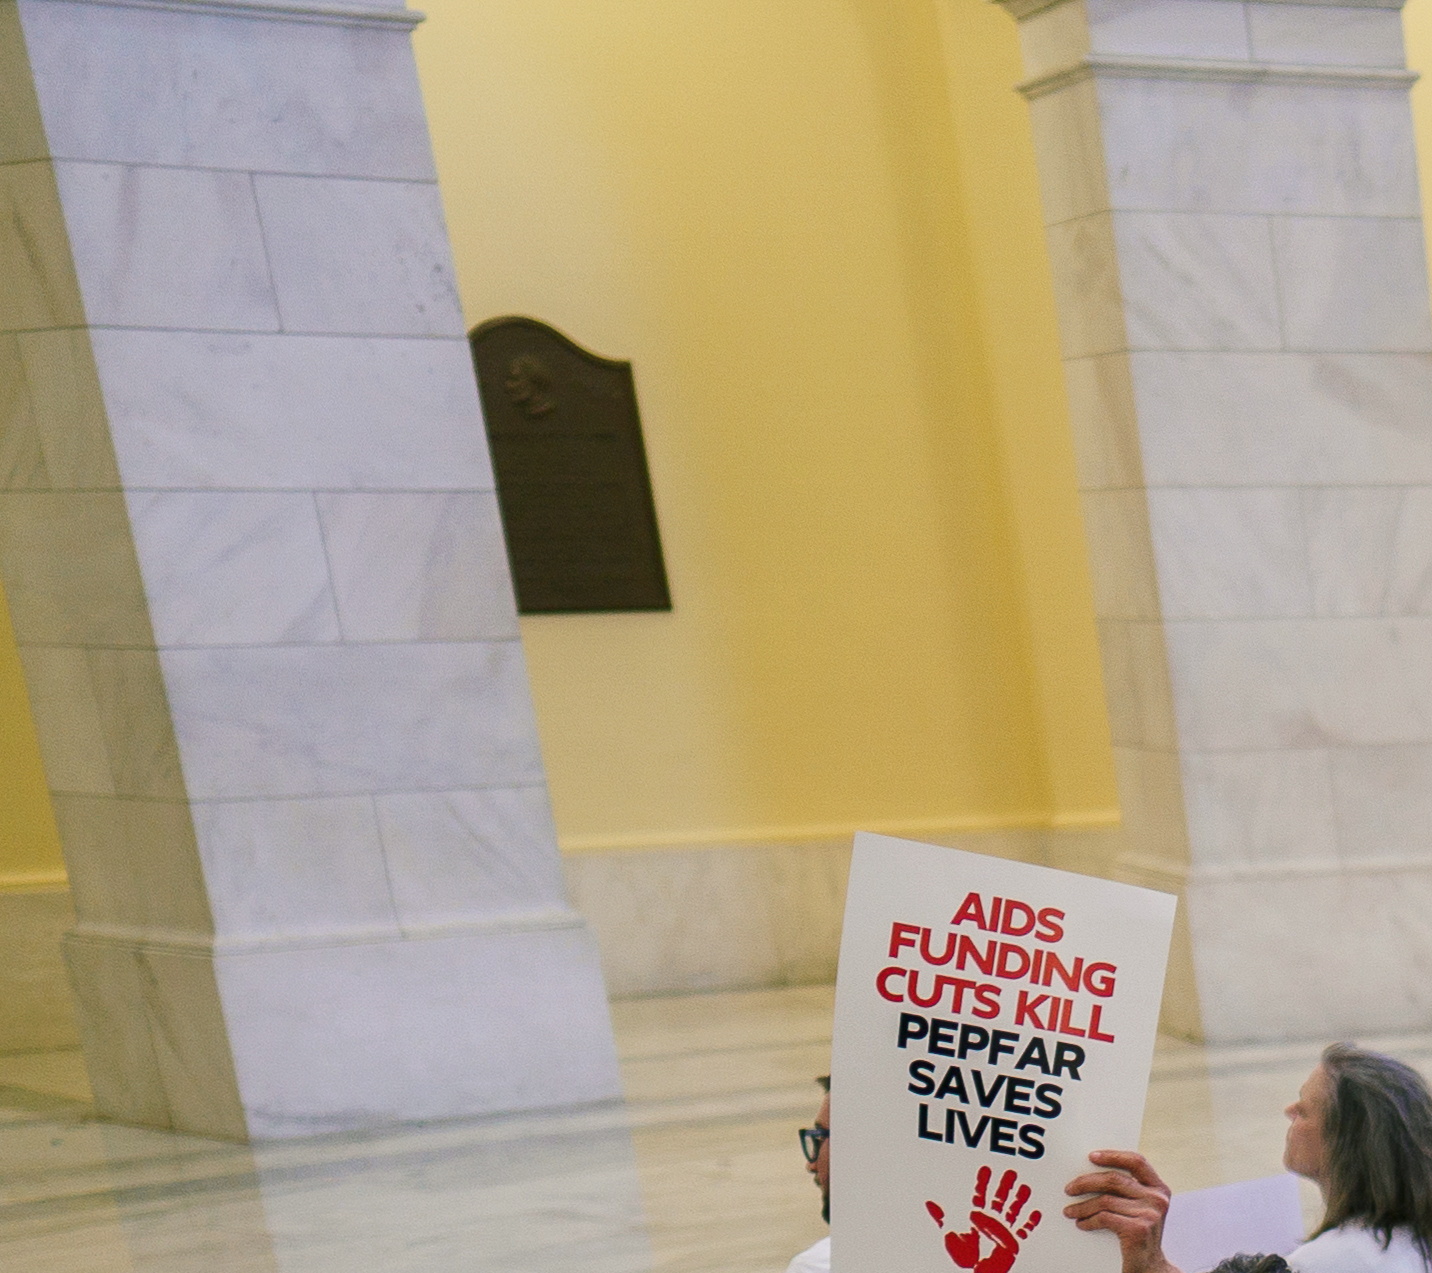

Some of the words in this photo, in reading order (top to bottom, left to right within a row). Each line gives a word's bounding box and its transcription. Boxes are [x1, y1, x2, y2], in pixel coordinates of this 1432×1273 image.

[951, 890, 1066, 944] AIDS
[887, 921, 1118, 999] FUNDING
[875, 965, 1002, 1020] CUTS
[1015, 990, 1116, 1045] KILL
[897, 1011, 1086, 1082] PEPFAR
[906, 1058, 1064, 1121] SAVES
[917, 1102, 1046, 1160] LIVES
